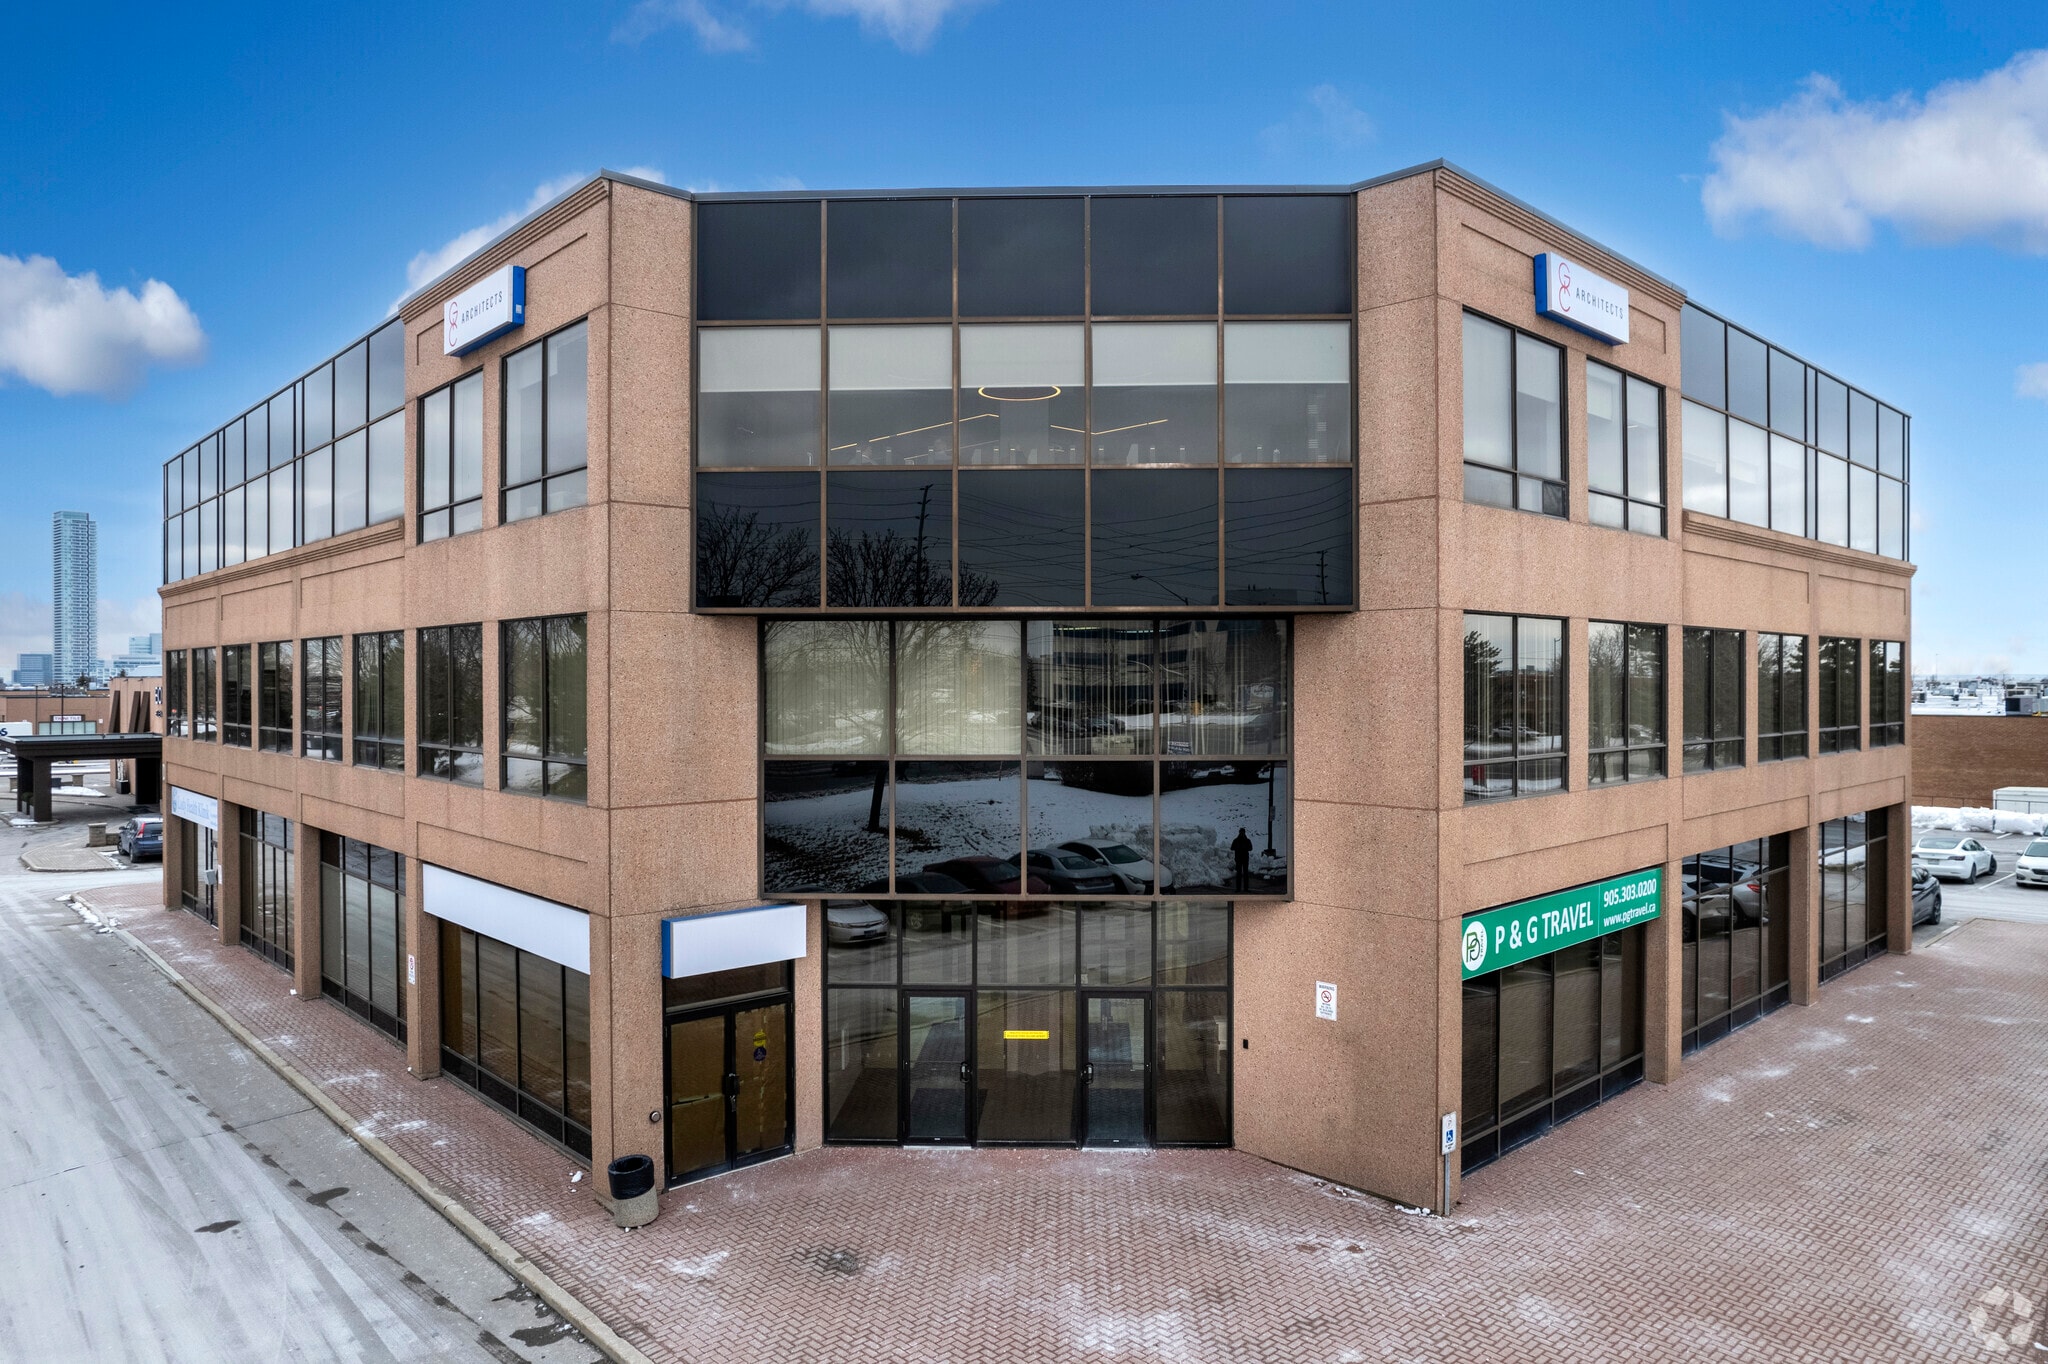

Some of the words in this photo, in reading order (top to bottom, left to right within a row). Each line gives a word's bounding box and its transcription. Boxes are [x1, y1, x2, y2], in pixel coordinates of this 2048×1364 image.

[462, 291, 502, 324] ARCHITECTS
[1576, 287, 1623, 320] ARCHITECTS
[1603, 878, 1657, 908] 905.303.0200
[1495, 925, 1505, 954] P
[1509, 919, 1522, 950] &
[1526, 915, 1538, 944] G
[1542, 901, 1593, 939] TRAVEL
[1603, 902, 1656, 928] www.pgtravel.ca
